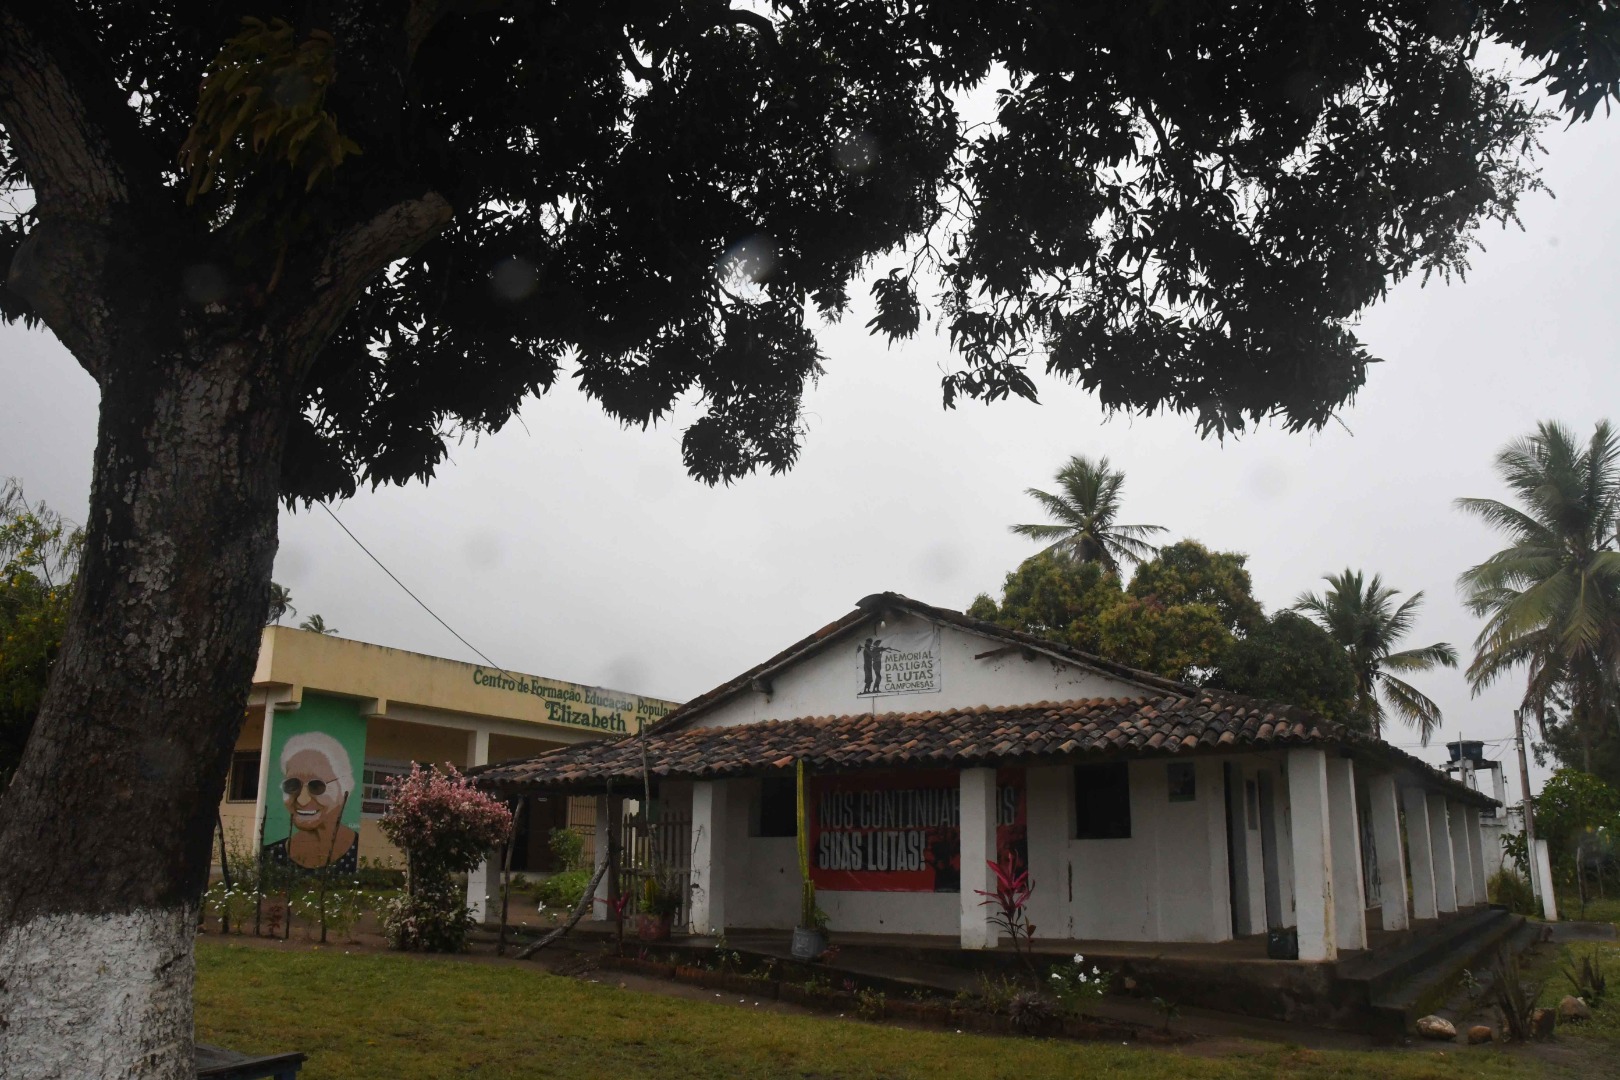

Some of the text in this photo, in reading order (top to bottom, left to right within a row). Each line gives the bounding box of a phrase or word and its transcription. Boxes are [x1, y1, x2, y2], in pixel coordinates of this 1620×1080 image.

[885, 650, 934, 663] MEMORIAL
[885, 660, 933, 672] DAS LIGAS
[885, 669, 934, 682] E LUTAS
[473, 669, 515, 691] Centro
[517, 677, 529, 693] de
[584, 688, 633, 712] Educação
[884, 680, 934, 690] CAMPONESAS
[544, 700, 627, 732] Elizabeth
[819, 829, 926, 871] SUAS LUTAS!
